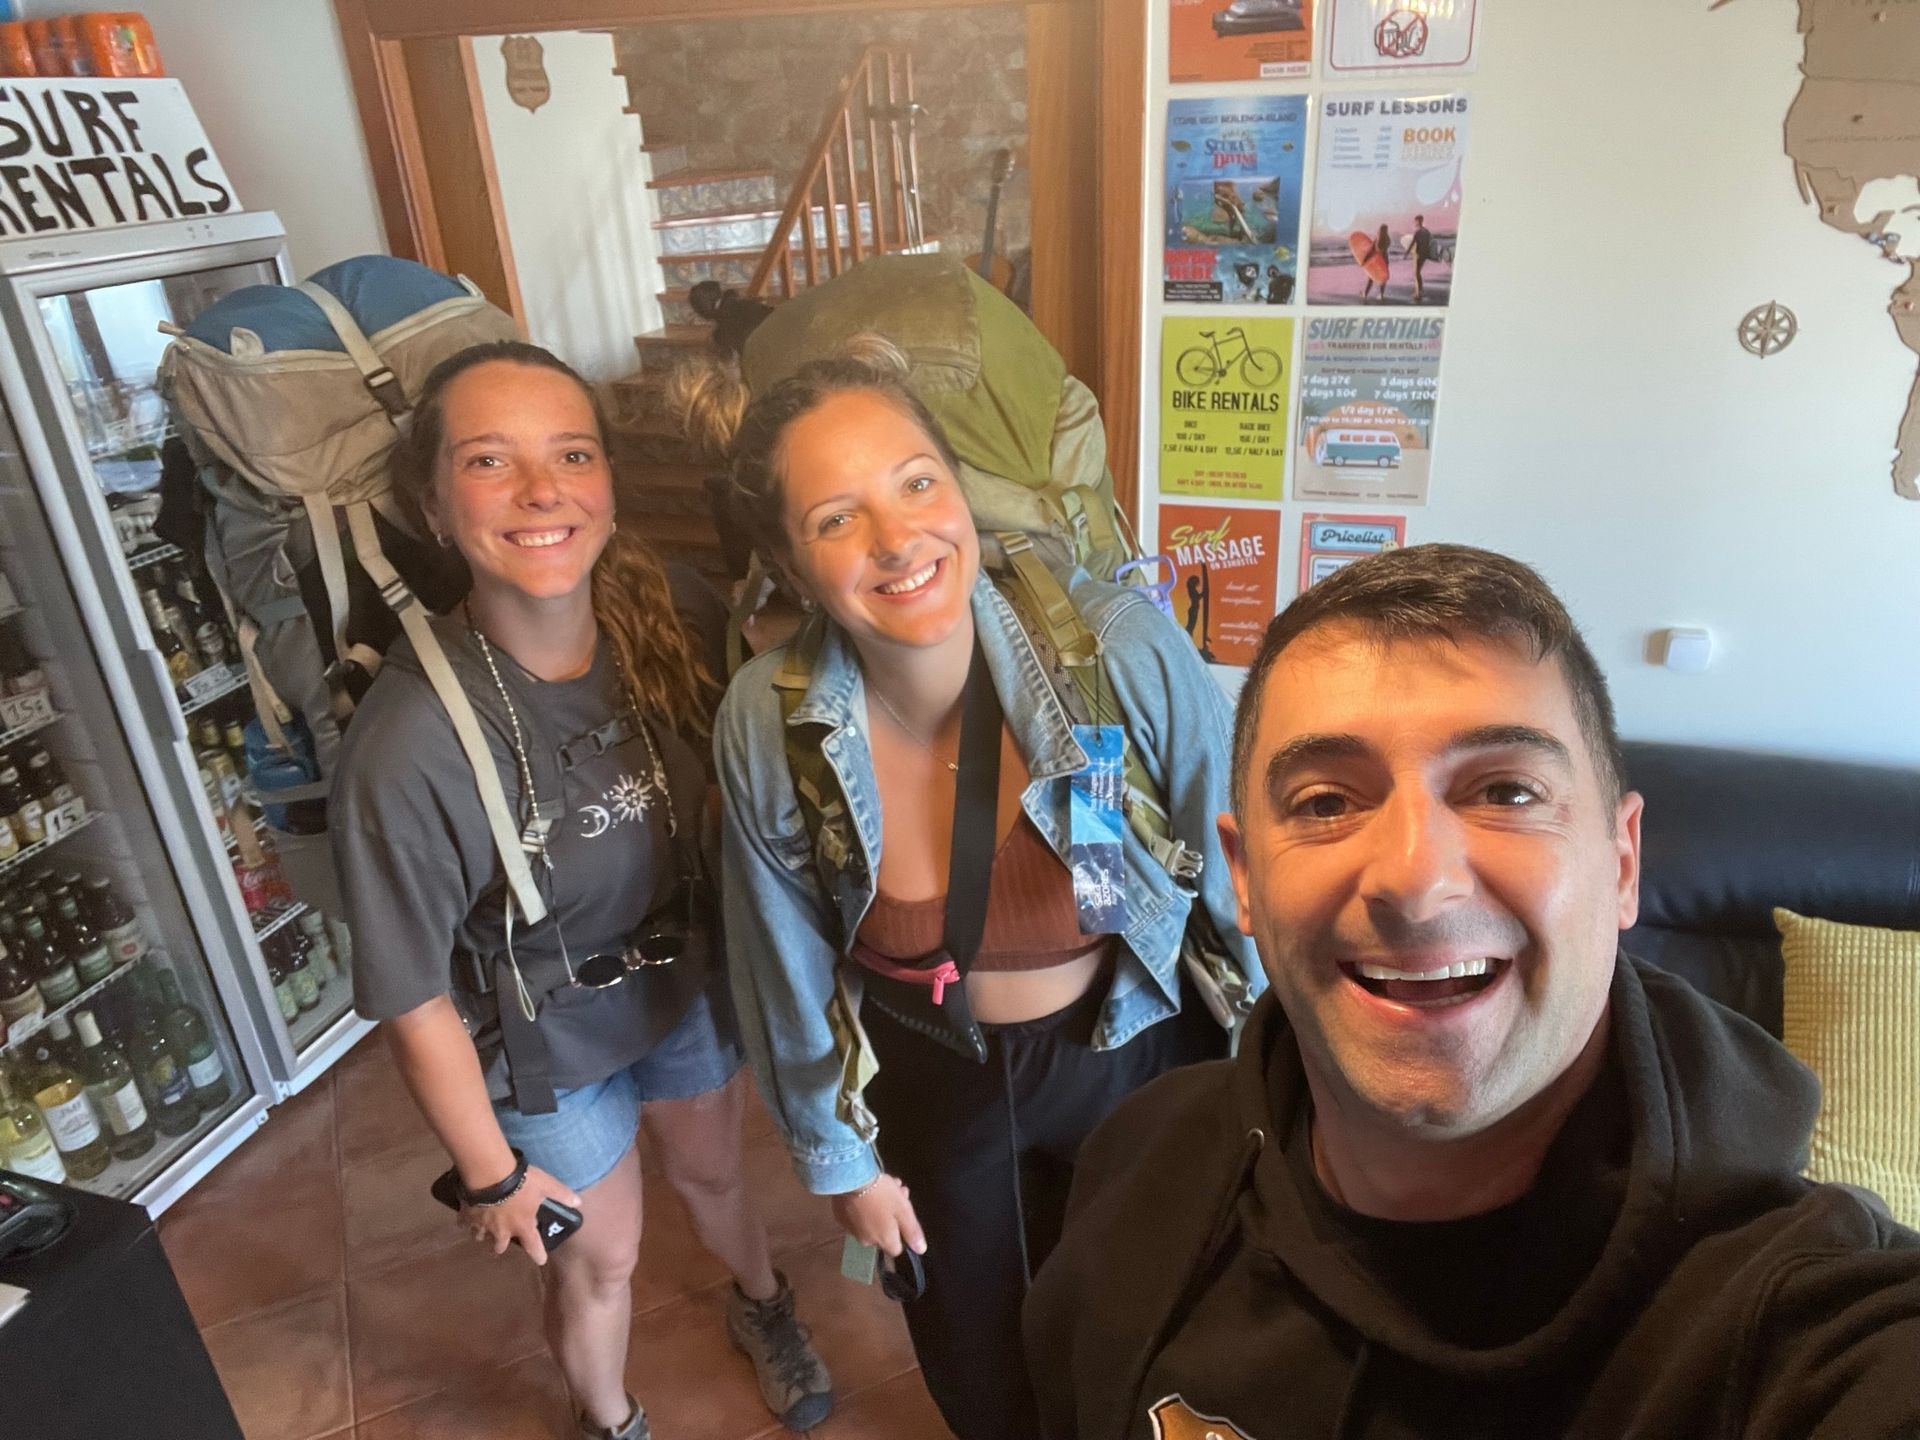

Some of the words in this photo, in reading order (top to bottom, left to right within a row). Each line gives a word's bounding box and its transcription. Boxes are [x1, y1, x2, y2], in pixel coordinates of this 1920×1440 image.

[1326, 101, 1375, 117] SURF
[1379, 98, 1468, 115] LESSONS
[0, 86, 143, 159] SURF
[1403, 126, 1456, 144] BOOK
[1308, 317, 1358, 339] SURF
[1360, 317, 1444, 339] RENTALS
[1310, 376, 1329, 387] day
[1389, 377, 1414, 389] days
[1172, 391, 1207, 410] BIKE
[1210, 392, 1280, 412] RENTALS
[1310, 388, 1334, 400] days
[1383, 390, 1408, 402] days
[1166, 515, 1232, 552] Surf
[1320, 528, 1385, 545] Pricelist
[1175, 535, 1266, 568] MASSAGE
